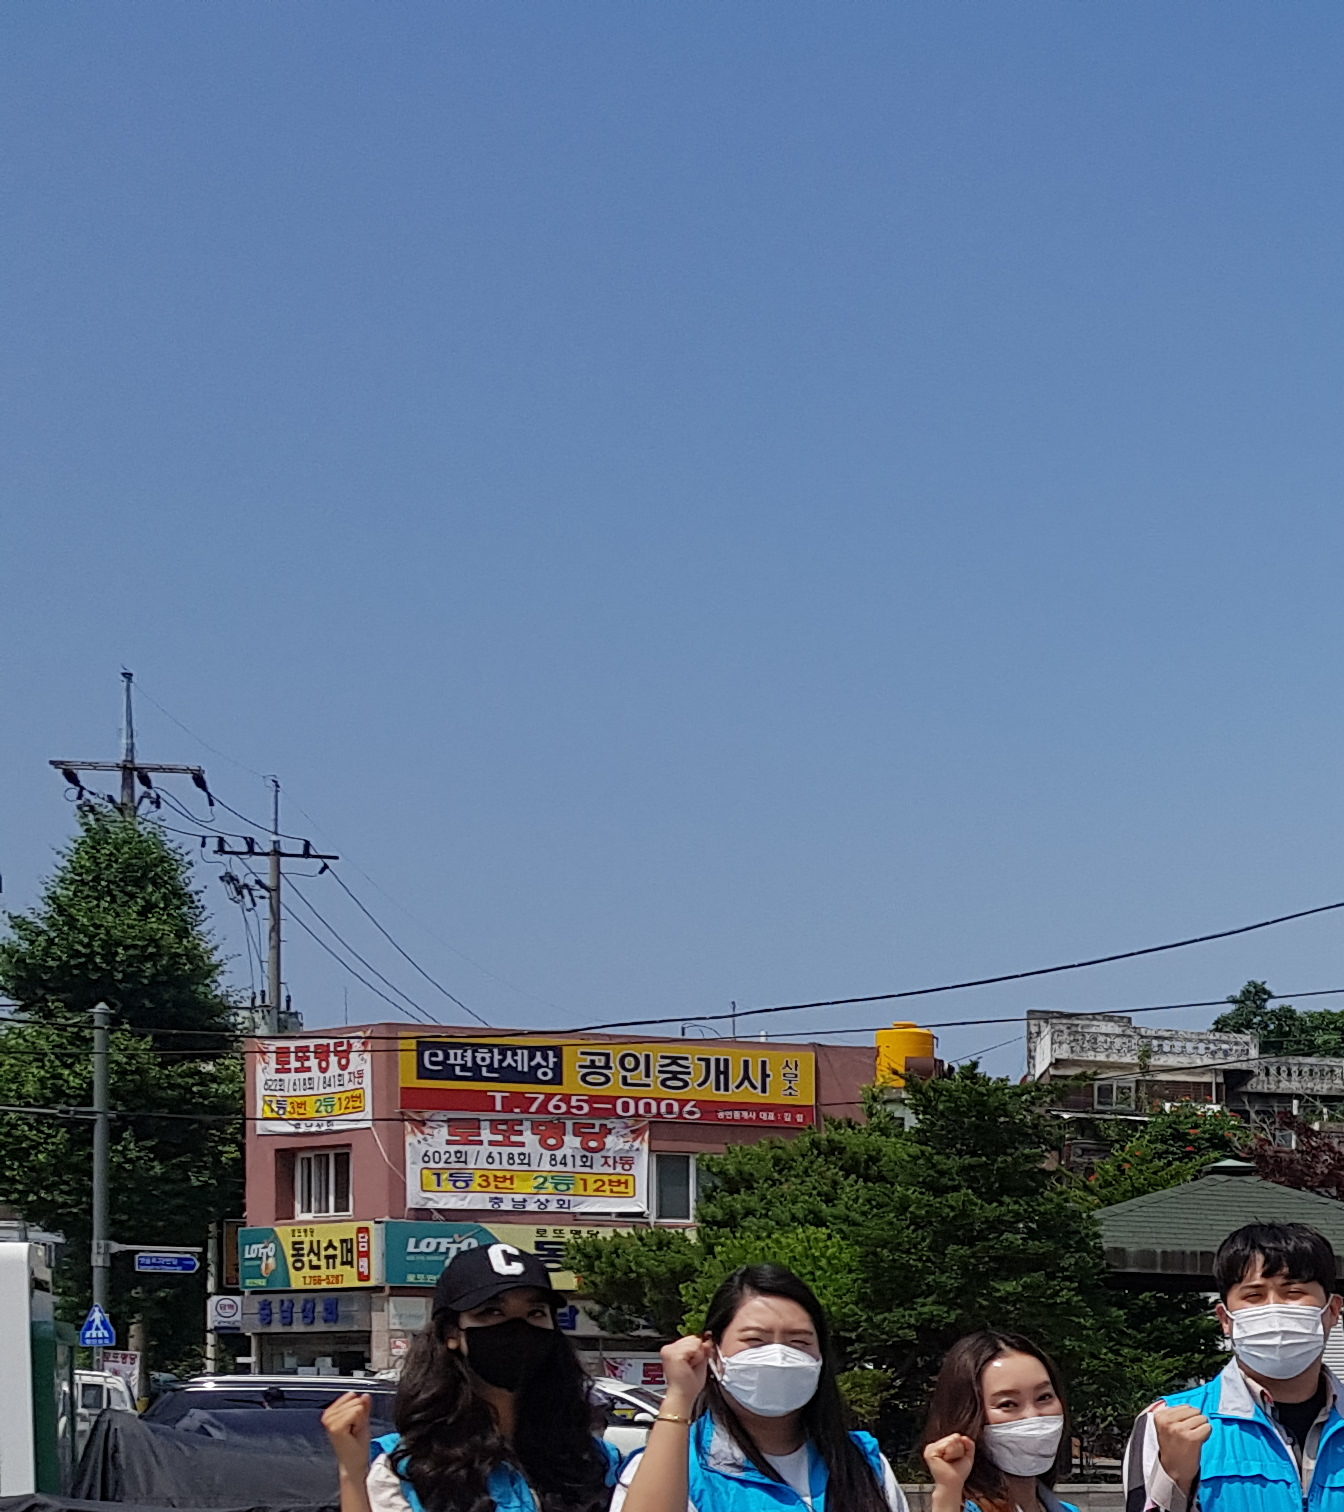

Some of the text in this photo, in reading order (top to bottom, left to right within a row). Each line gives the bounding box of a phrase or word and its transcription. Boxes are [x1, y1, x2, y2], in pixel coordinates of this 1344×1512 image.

[348, 1069, 364, 1085] 자동
[422, 1047, 773, 1095] e편한세상 공인중개사
[781, 1058, 801, 1097] 사무소
[487, 1090, 702, 1120] T.765-0006
[445, 1118, 613, 1153] 로또명당
[421, 1149, 468, 1166] 602회
[485, 1151, 531, 1168] 618회
[549, 1153, 594, 1169] 841회
[600, 1155, 635, 1172] 자동
[290, 1238, 354, 1272] 동신슈퍼
[406, 1237, 479, 1257] LOTTO
[487, 1243, 526, 1276] C
